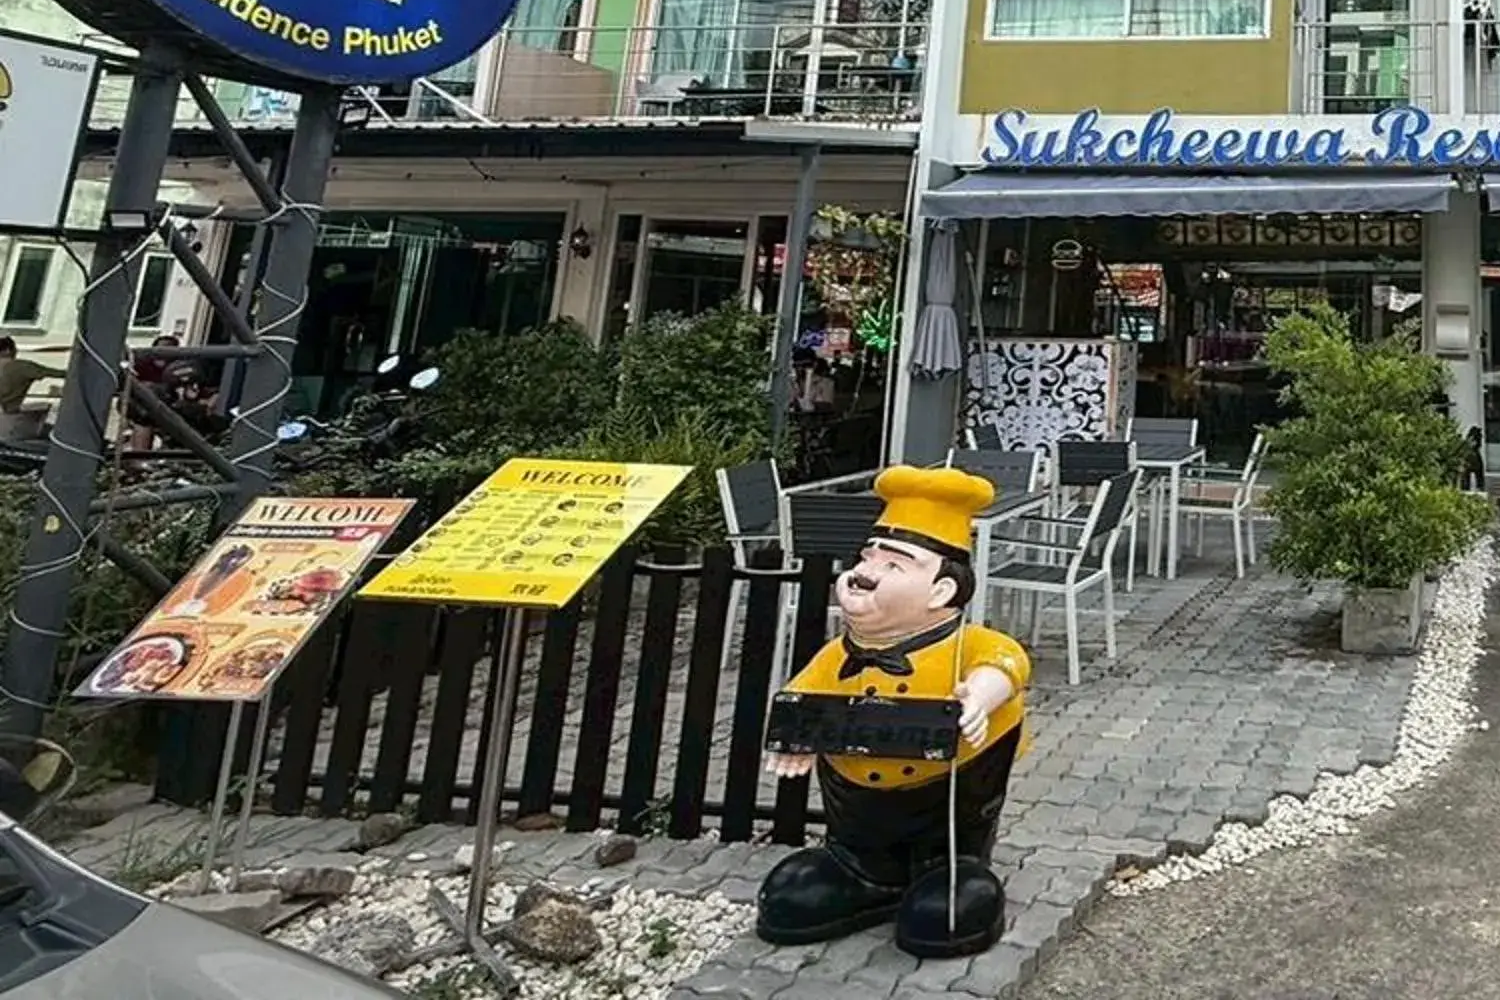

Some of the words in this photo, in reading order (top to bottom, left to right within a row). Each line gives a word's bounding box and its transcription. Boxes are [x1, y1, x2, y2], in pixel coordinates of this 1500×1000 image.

[342, 19, 443, 56] Phuket
[981, 105, 1352, 166] Sukcheewa
[520, 469, 652, 489] WELCOME
